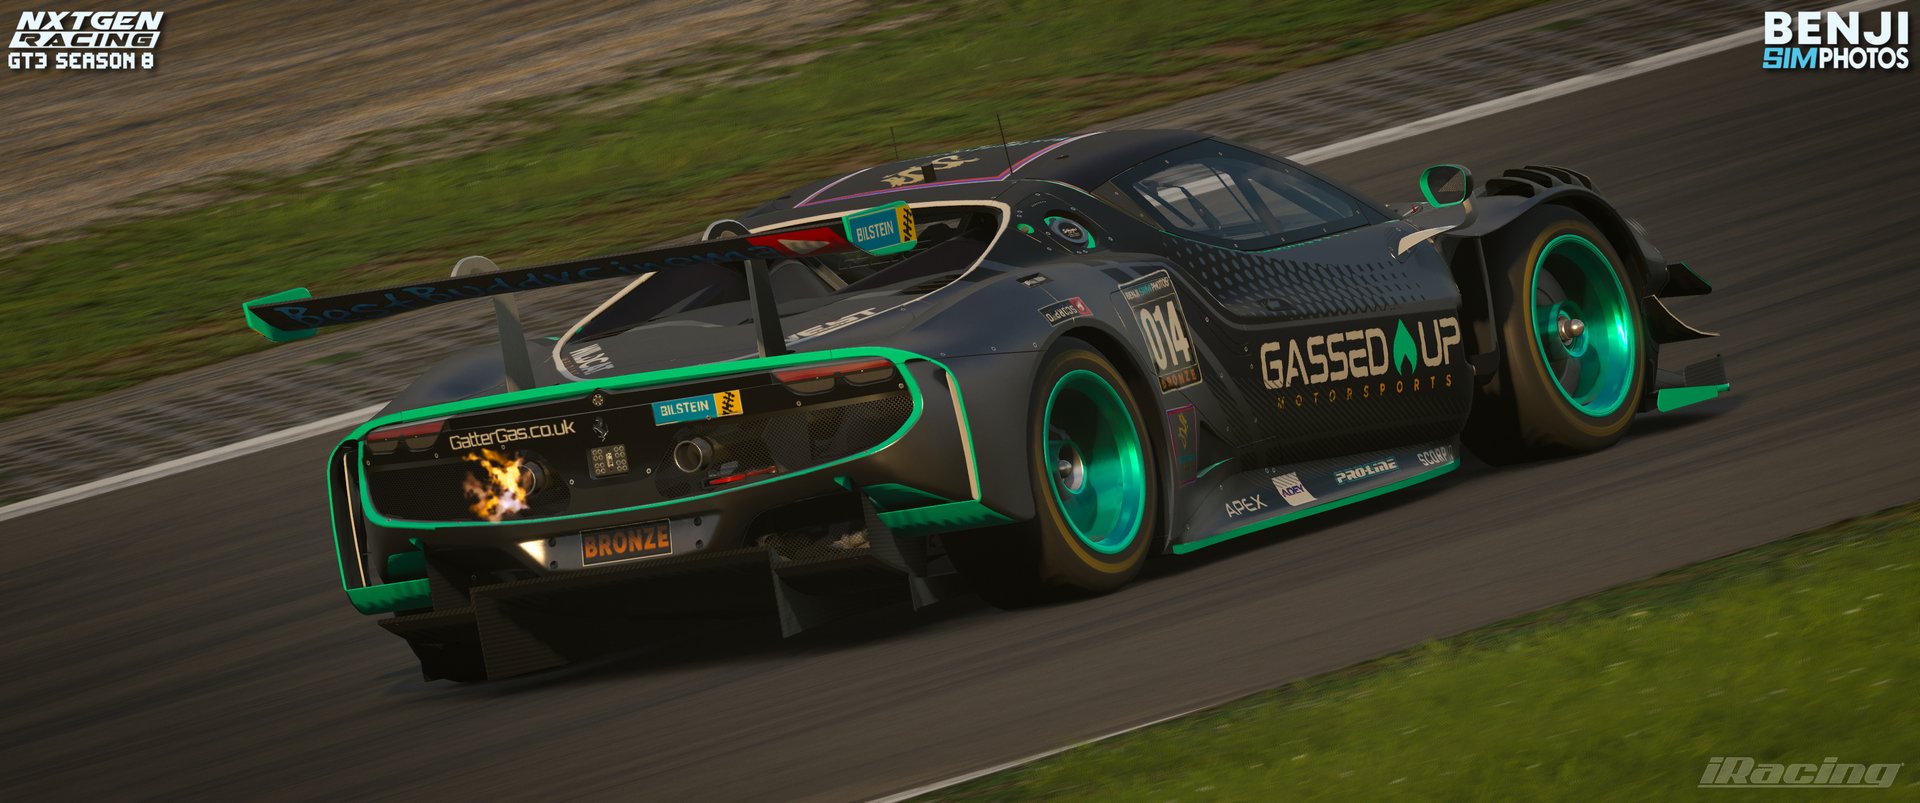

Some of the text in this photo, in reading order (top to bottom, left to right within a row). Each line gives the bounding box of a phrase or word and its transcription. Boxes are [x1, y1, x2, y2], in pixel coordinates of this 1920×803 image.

[856, 220, 894, 242] BILSTEIN
[1140, 301, 1191, 371] 014
[1260, 317, 1461, 389] GASSED UP
[1277, 374, 1452, 409] MOTORSPORTS
[660, 400, 709, 417] BILSTEIN
[449, 419, 576, 450] GatterGas.co.uk
[1225, 494, 1268, 518] APEX
[1281, 485, 1305, 498] ADEY
[585, 525, 670, 558] BRONZE
